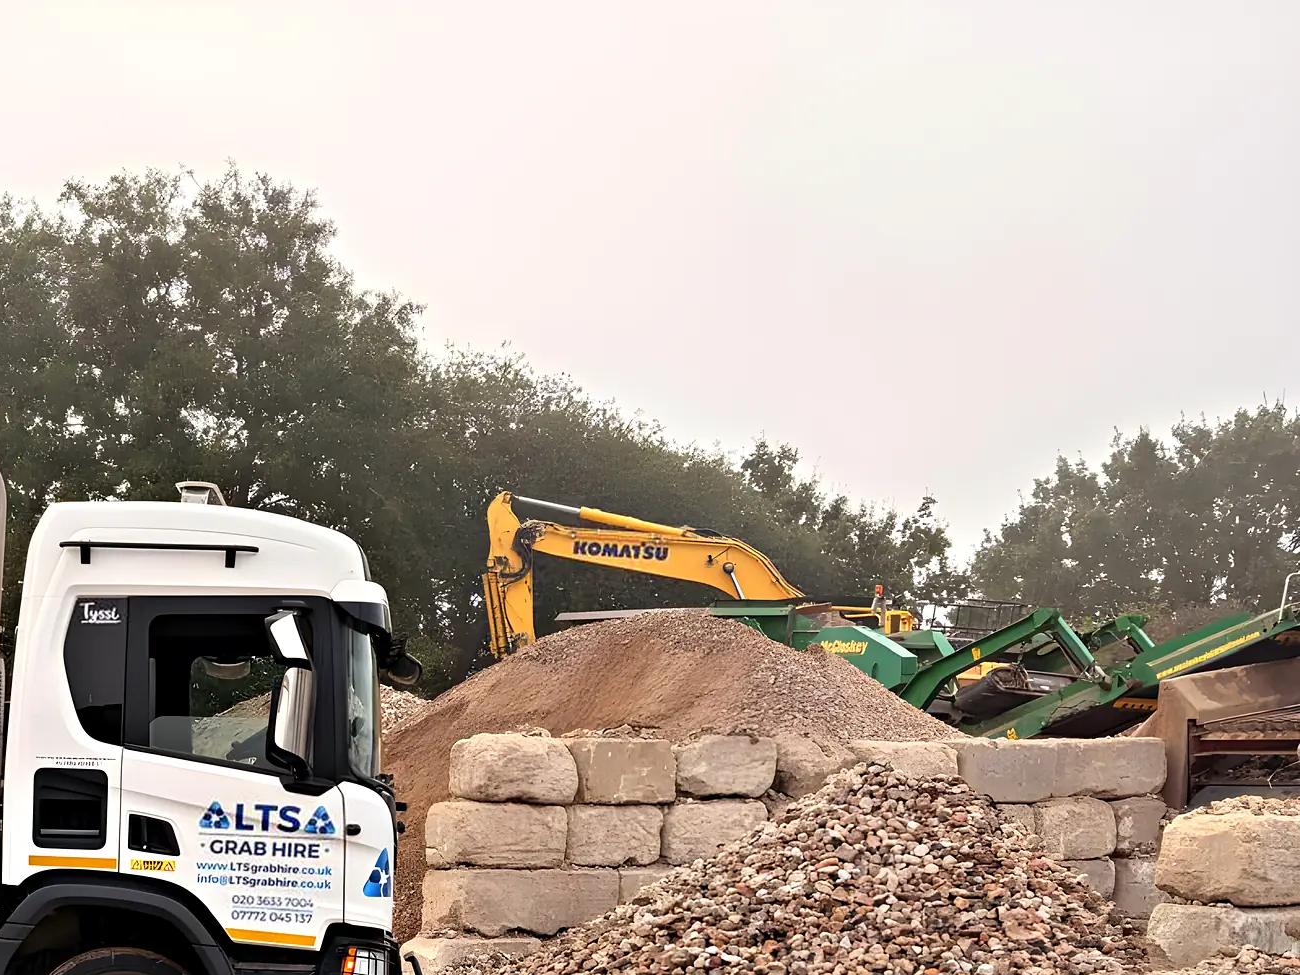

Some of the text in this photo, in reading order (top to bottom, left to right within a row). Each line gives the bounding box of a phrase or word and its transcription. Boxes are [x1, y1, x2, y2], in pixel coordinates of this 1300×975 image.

[573, 540, 669, 560] KOMATSU
[235, 803, 301, 833] LTS
[209, 839, 321, 859] GRAB HIRE
[196, 862, 332, 876] www.LTSgrabhire.co.uk
[197, 874, 331, 889] info@LTSgrabhire.co.uk
[231, 895, 255, 905] 020
[231, 910, 313, 924] 07772 045 137
